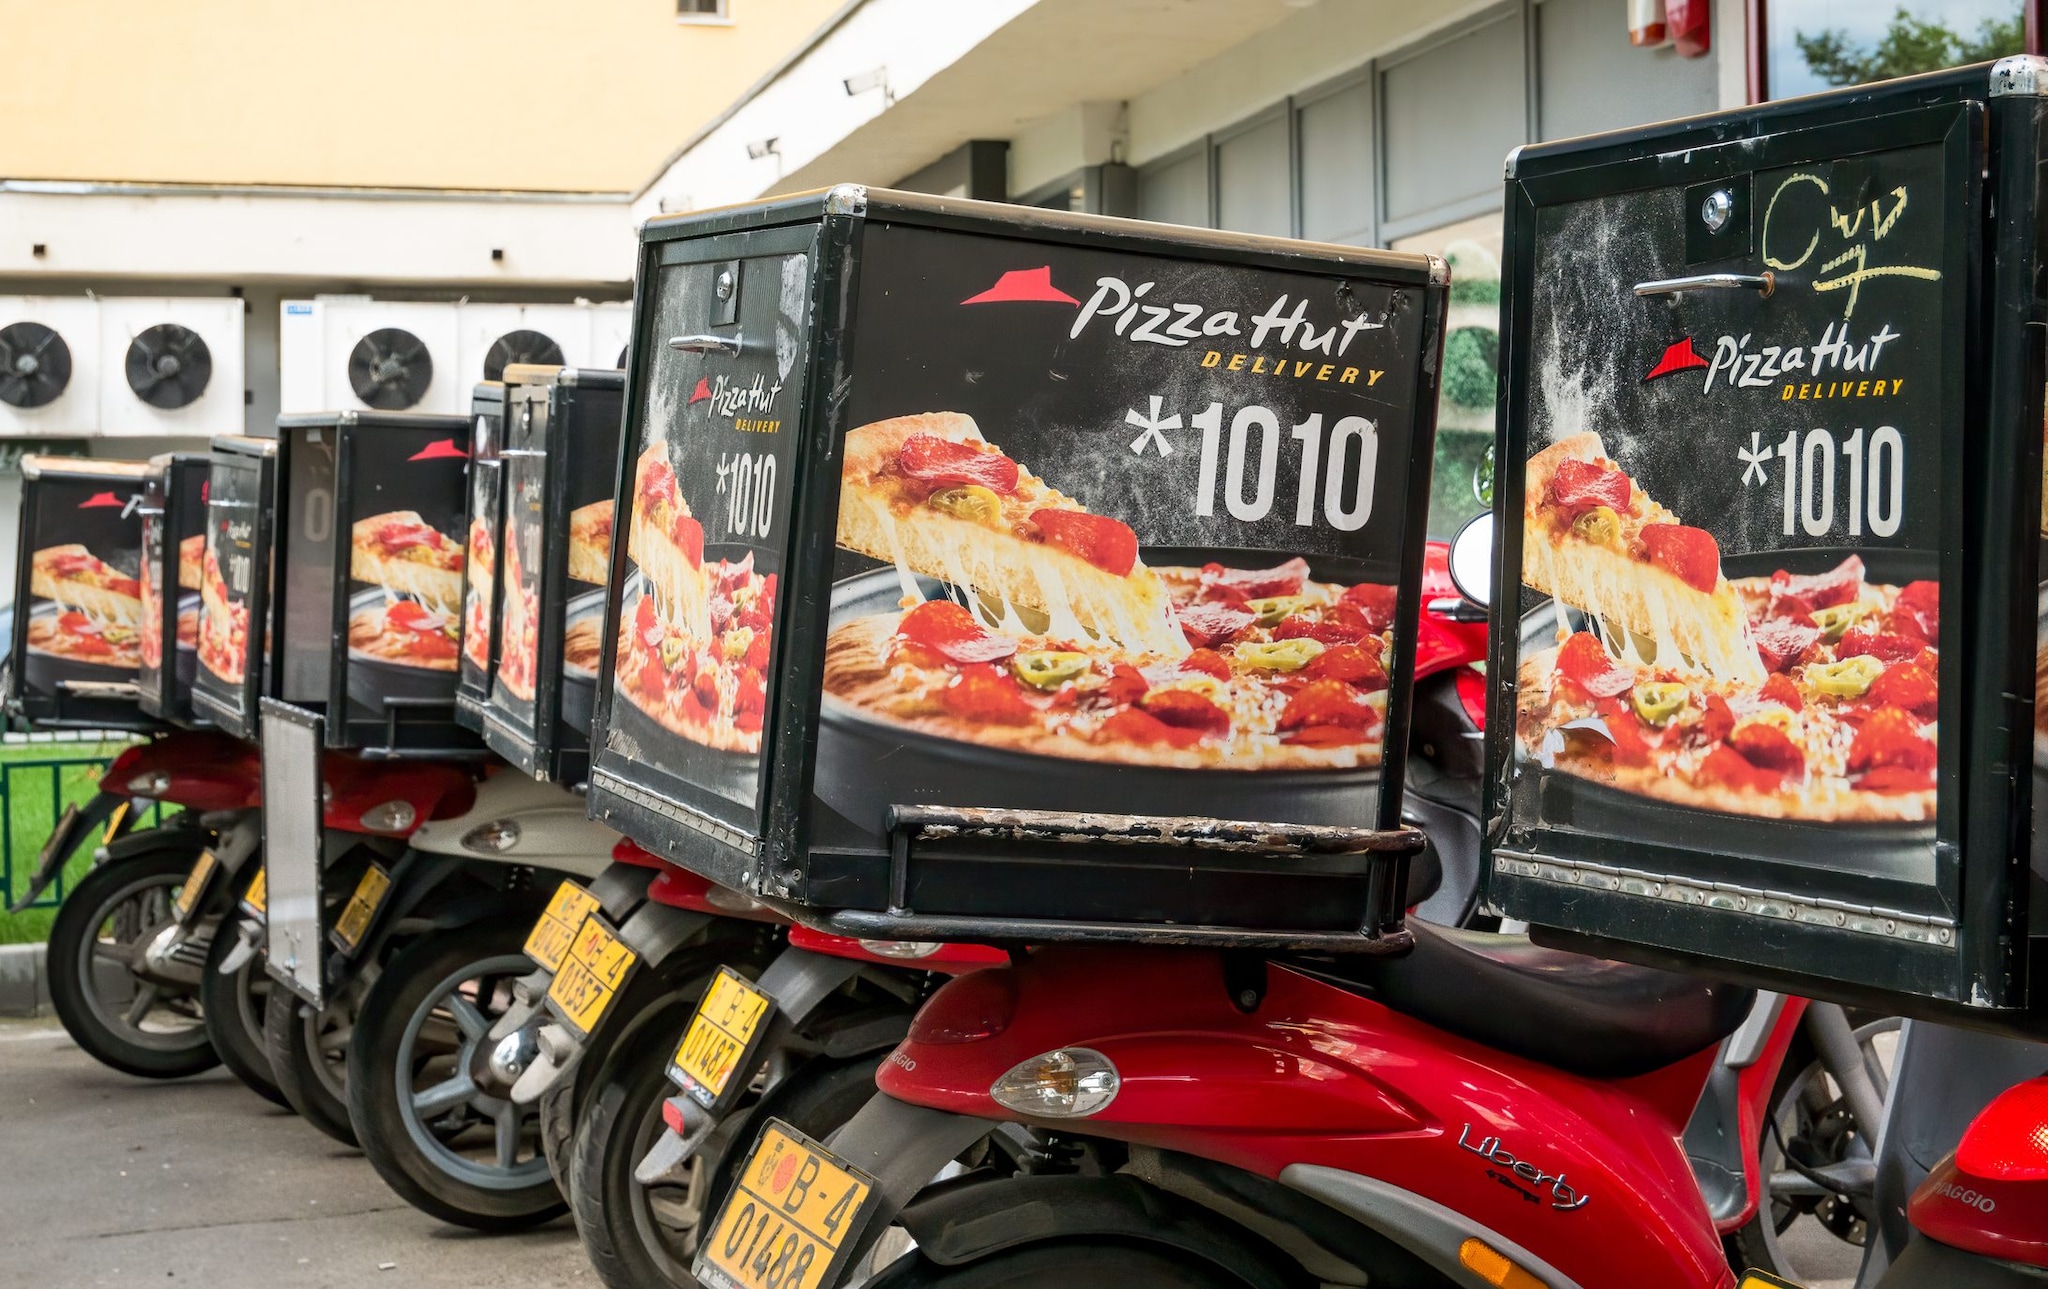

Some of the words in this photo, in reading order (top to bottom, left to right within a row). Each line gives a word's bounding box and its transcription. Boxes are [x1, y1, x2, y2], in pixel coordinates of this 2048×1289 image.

[1070, 276, 1241, 346] Pizza
[1250, 294, 1384, 357] Hut
[1200, 351, 1385, 386] DELIVERY
[1703, 333, 1806, 394] Pizza
[1811, 321, 1900, 377] Hut
[708, 374, 747, 418] Pizza
[749, 372, 782, 414] Hut
[1781, 379, 1904, 401] DELIVERY
[735, 419, 781, 433] DELIVERY
[556, 961, 604, 1018] 01357
[685, 1022, 736, 1084] 01487
[1458, 1122, 1590, 1210] Liberty
[724, 1202, 816, 1289] 01488
